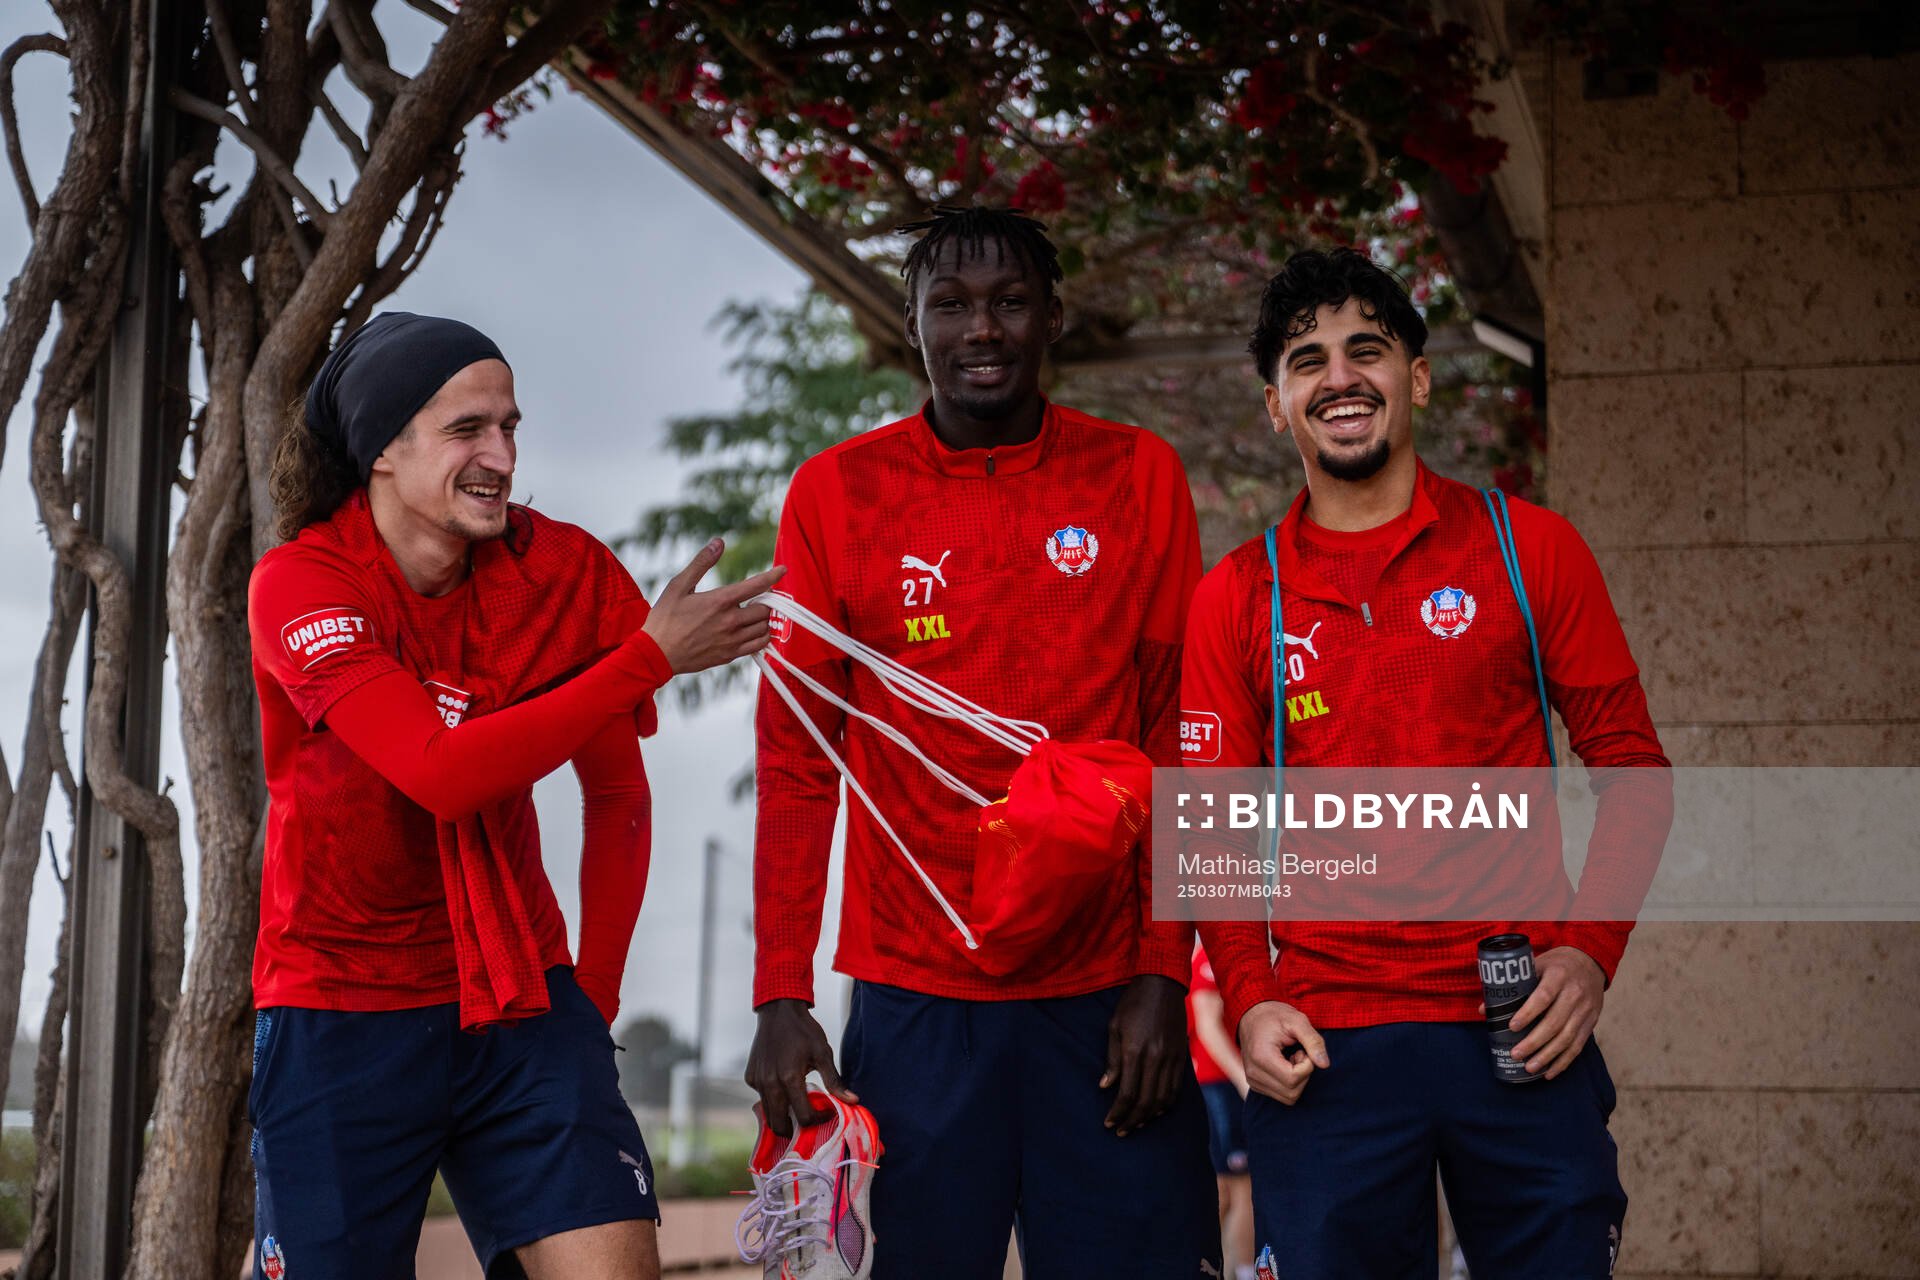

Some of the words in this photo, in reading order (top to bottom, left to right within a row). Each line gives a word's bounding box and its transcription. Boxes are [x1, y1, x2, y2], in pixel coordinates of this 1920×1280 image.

[902, 577, 933, 607] 27
[287, 616, 365, 652] UNIBET
[904, 614, 951, 643] XXL
[1285, 690, 1330, 723] XXL
[633, 1169, 648, 1196] 8
